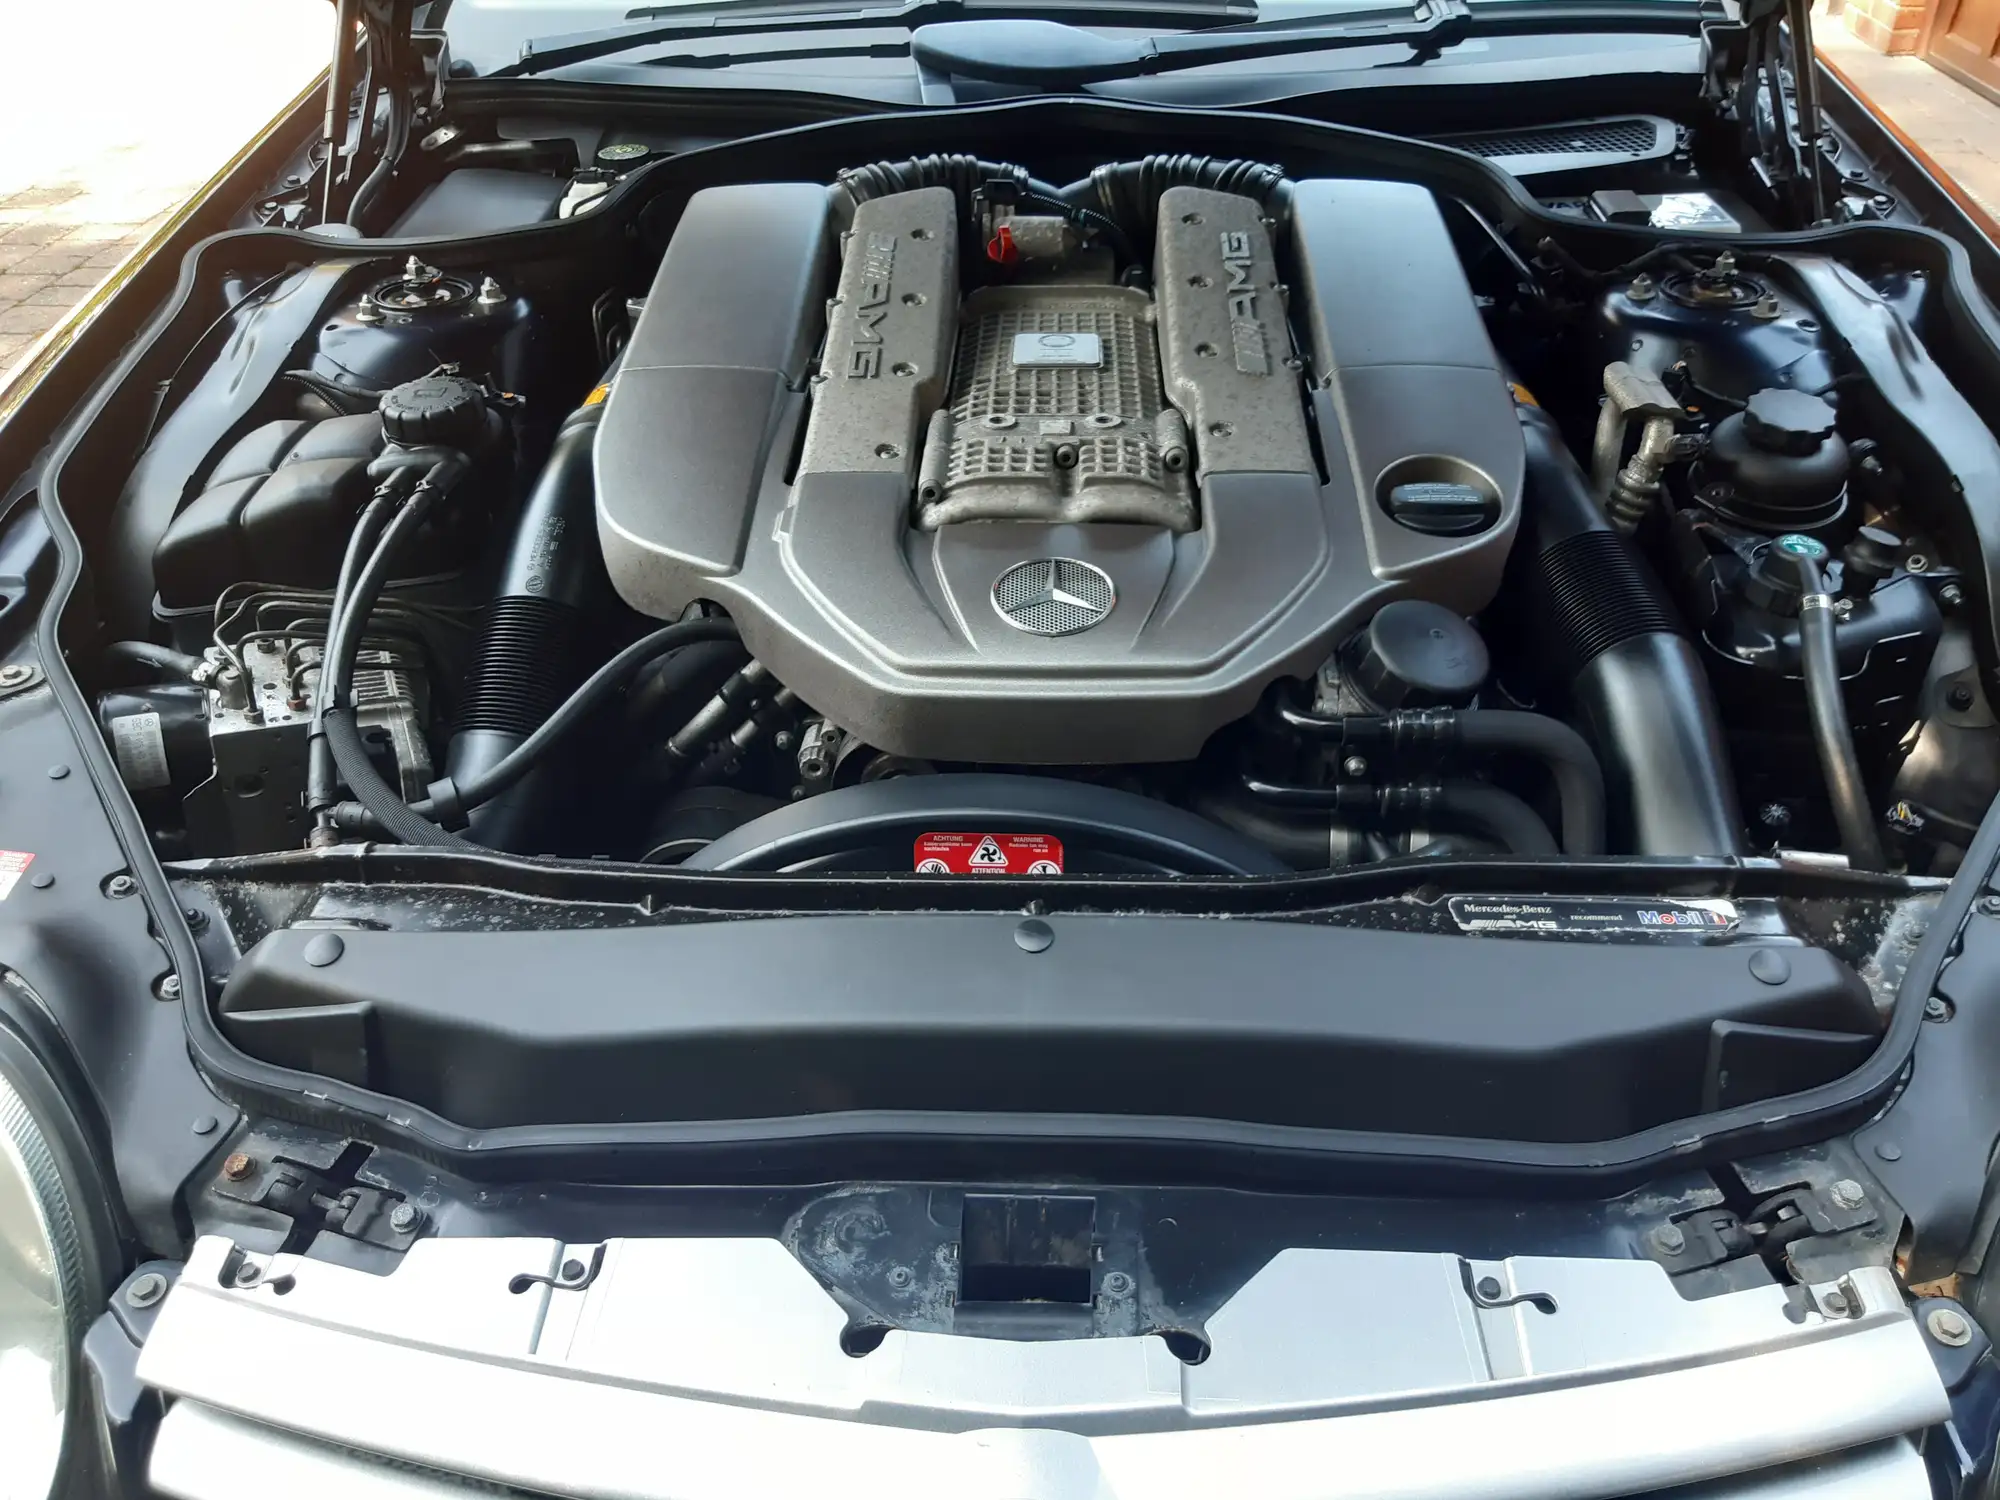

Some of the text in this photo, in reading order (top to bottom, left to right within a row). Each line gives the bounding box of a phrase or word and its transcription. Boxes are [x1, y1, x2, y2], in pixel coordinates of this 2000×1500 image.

[1464, 903, 1553, 914] Mercedes-Benz
[1636, 910, 1705, 925] Mobil
[1495, 919, 1558, 929] AMG
